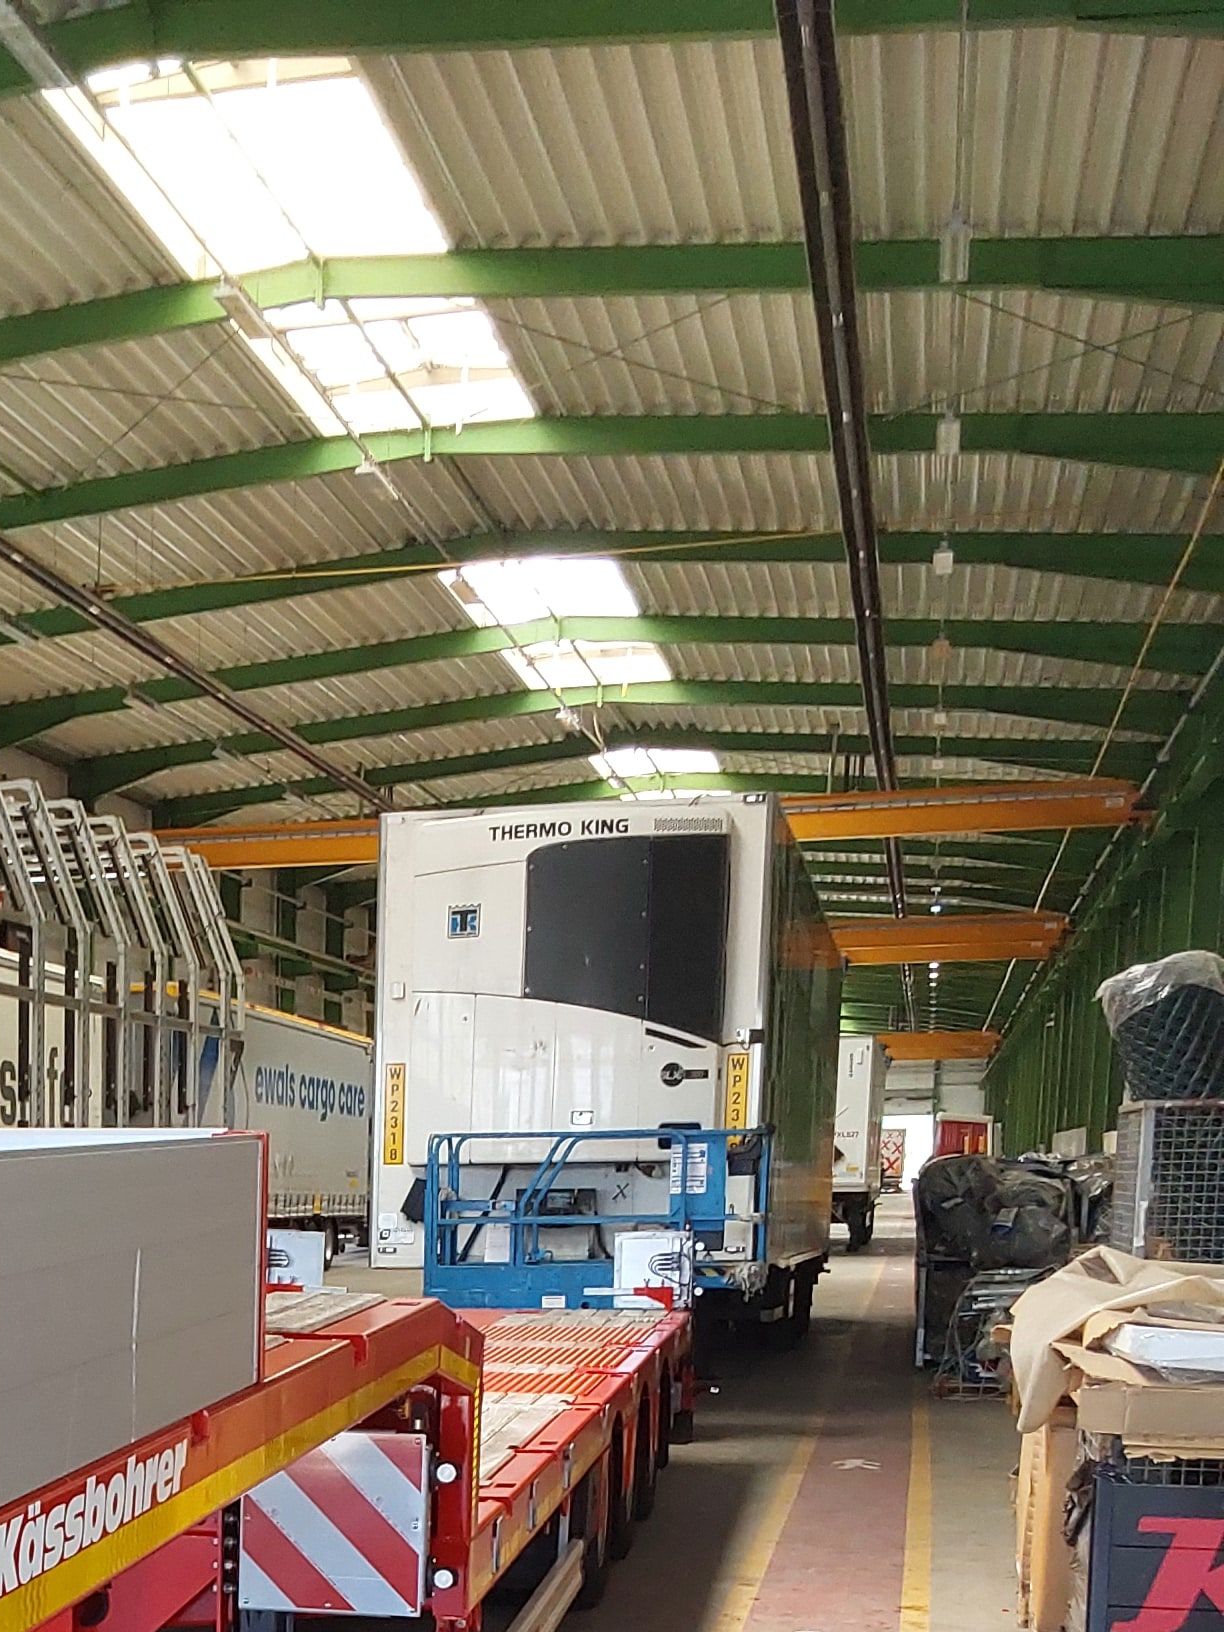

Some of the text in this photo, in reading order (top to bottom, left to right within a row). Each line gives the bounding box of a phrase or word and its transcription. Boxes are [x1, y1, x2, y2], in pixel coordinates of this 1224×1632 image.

[488, 818, 629, 842] THERMO KING
[255, 1063, 366, 1122] ewals cargo care
[388, 1066, 402, 1161] WP2318
